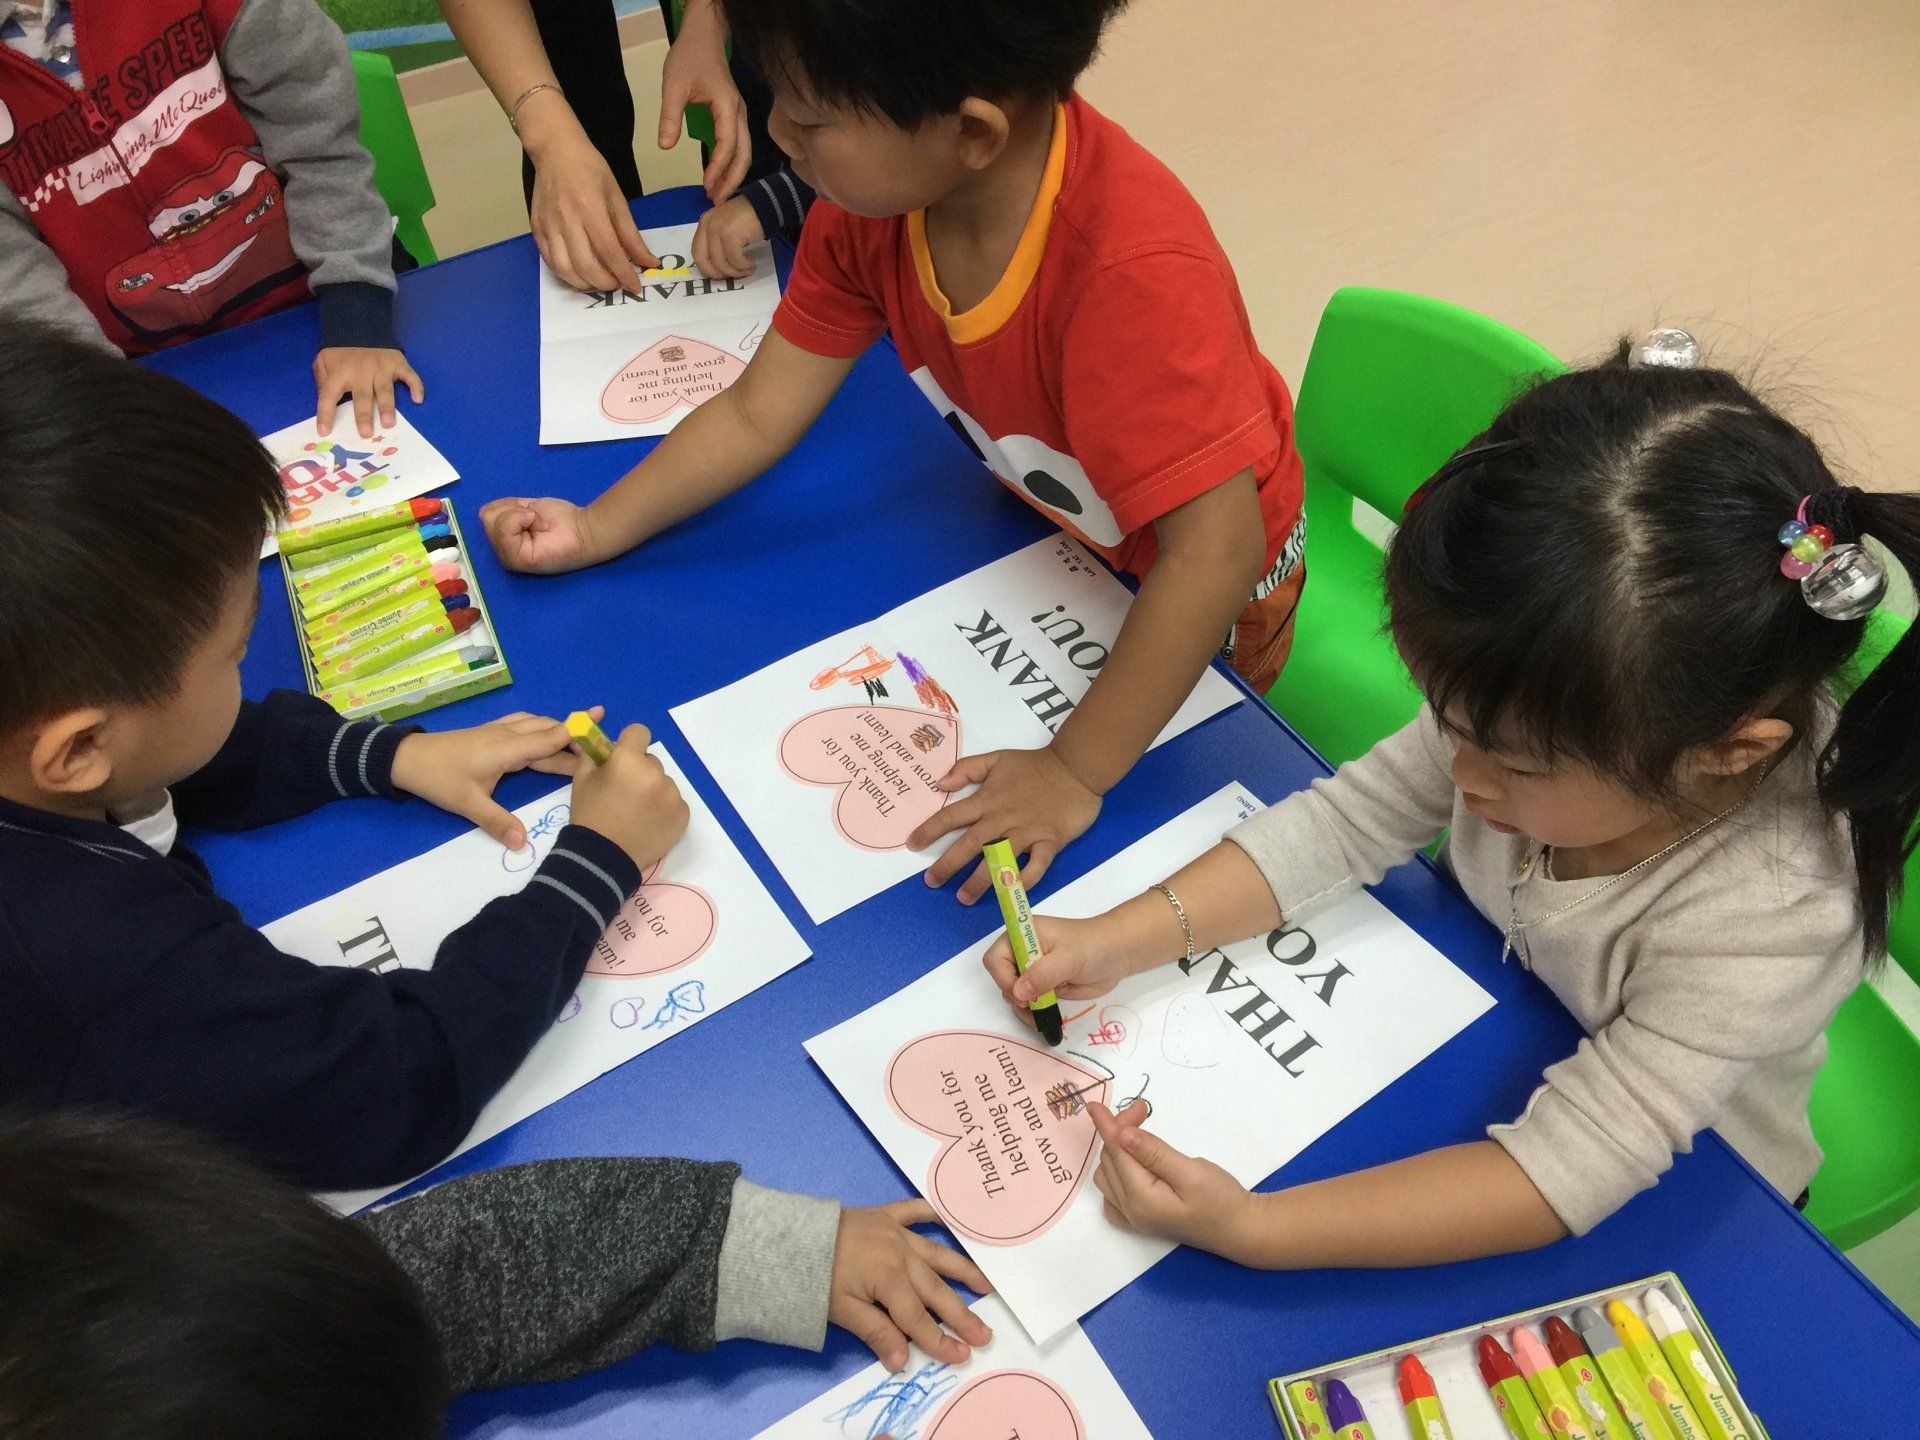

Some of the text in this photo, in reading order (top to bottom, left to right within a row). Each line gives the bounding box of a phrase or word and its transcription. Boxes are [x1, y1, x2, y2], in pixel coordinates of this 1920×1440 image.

[582, 277, 745, 309] THANK
[621, 355, 726, 382] grow and learn!
[637, 371, 713, 390] helping me
[628, 382, 725, 403] Thank you for
[1030, 605, 1109, 684] OU!
[954, 608, 1076, 736] HANK
[856, 710, 893, 744] learn!
[850, 733, 912, 796] helping me
[887, 740, 914, 763] and
[821, 736, 896, 818] Thank you for
[616, 919, 636, 942] me
[647, 915, 668, 937] for
[1013, 888, 1038, 955] Jumbo Crayon
[974, 1073, 1030, 1177] helping me
[988, 1045, 1073, 1184] grow and learn!
[940, 1070, 1006, 1199] Thank you for
[1668, 1402, 1696, 1440] Jumbo
[1709, 1392, 1736, 1432] Jumbo
